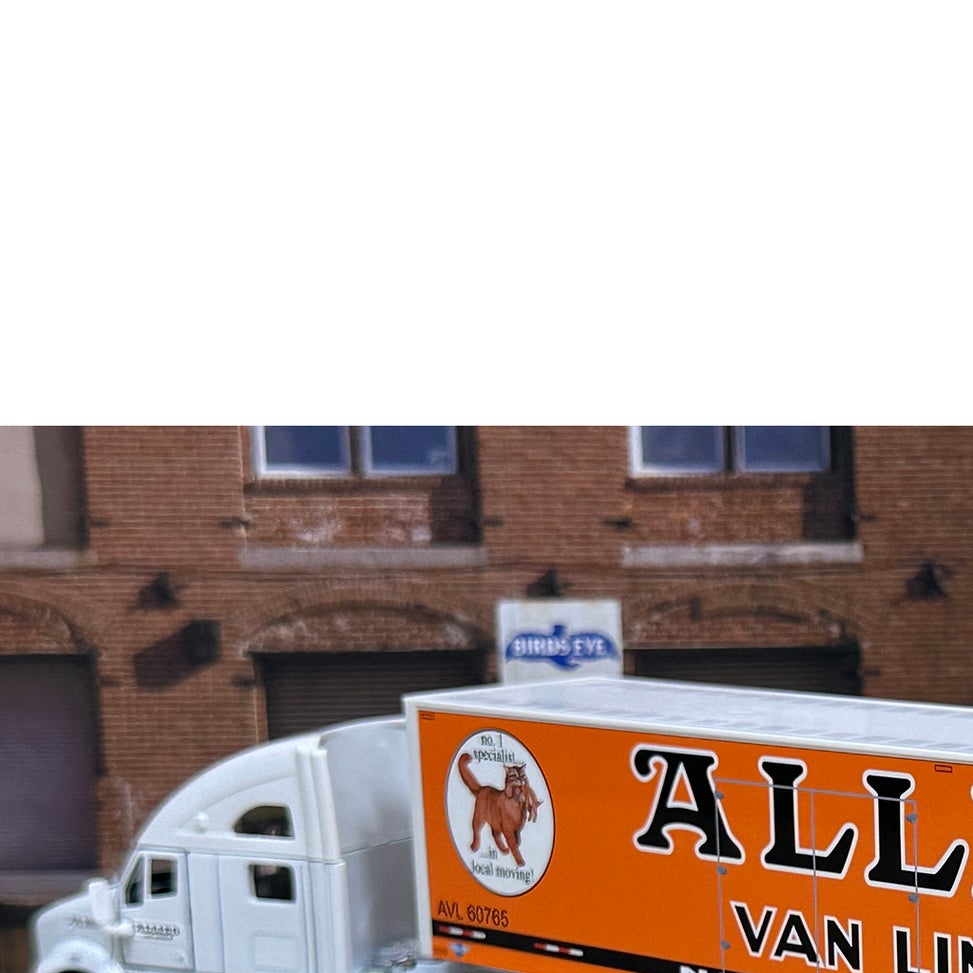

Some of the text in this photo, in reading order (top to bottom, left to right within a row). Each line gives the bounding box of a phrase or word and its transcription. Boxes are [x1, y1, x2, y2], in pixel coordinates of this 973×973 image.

[571, 637, 607, 657] EYE
[472, 860, 535, 885] local moving!
[438, 900, 509, 928] AVL 60765
